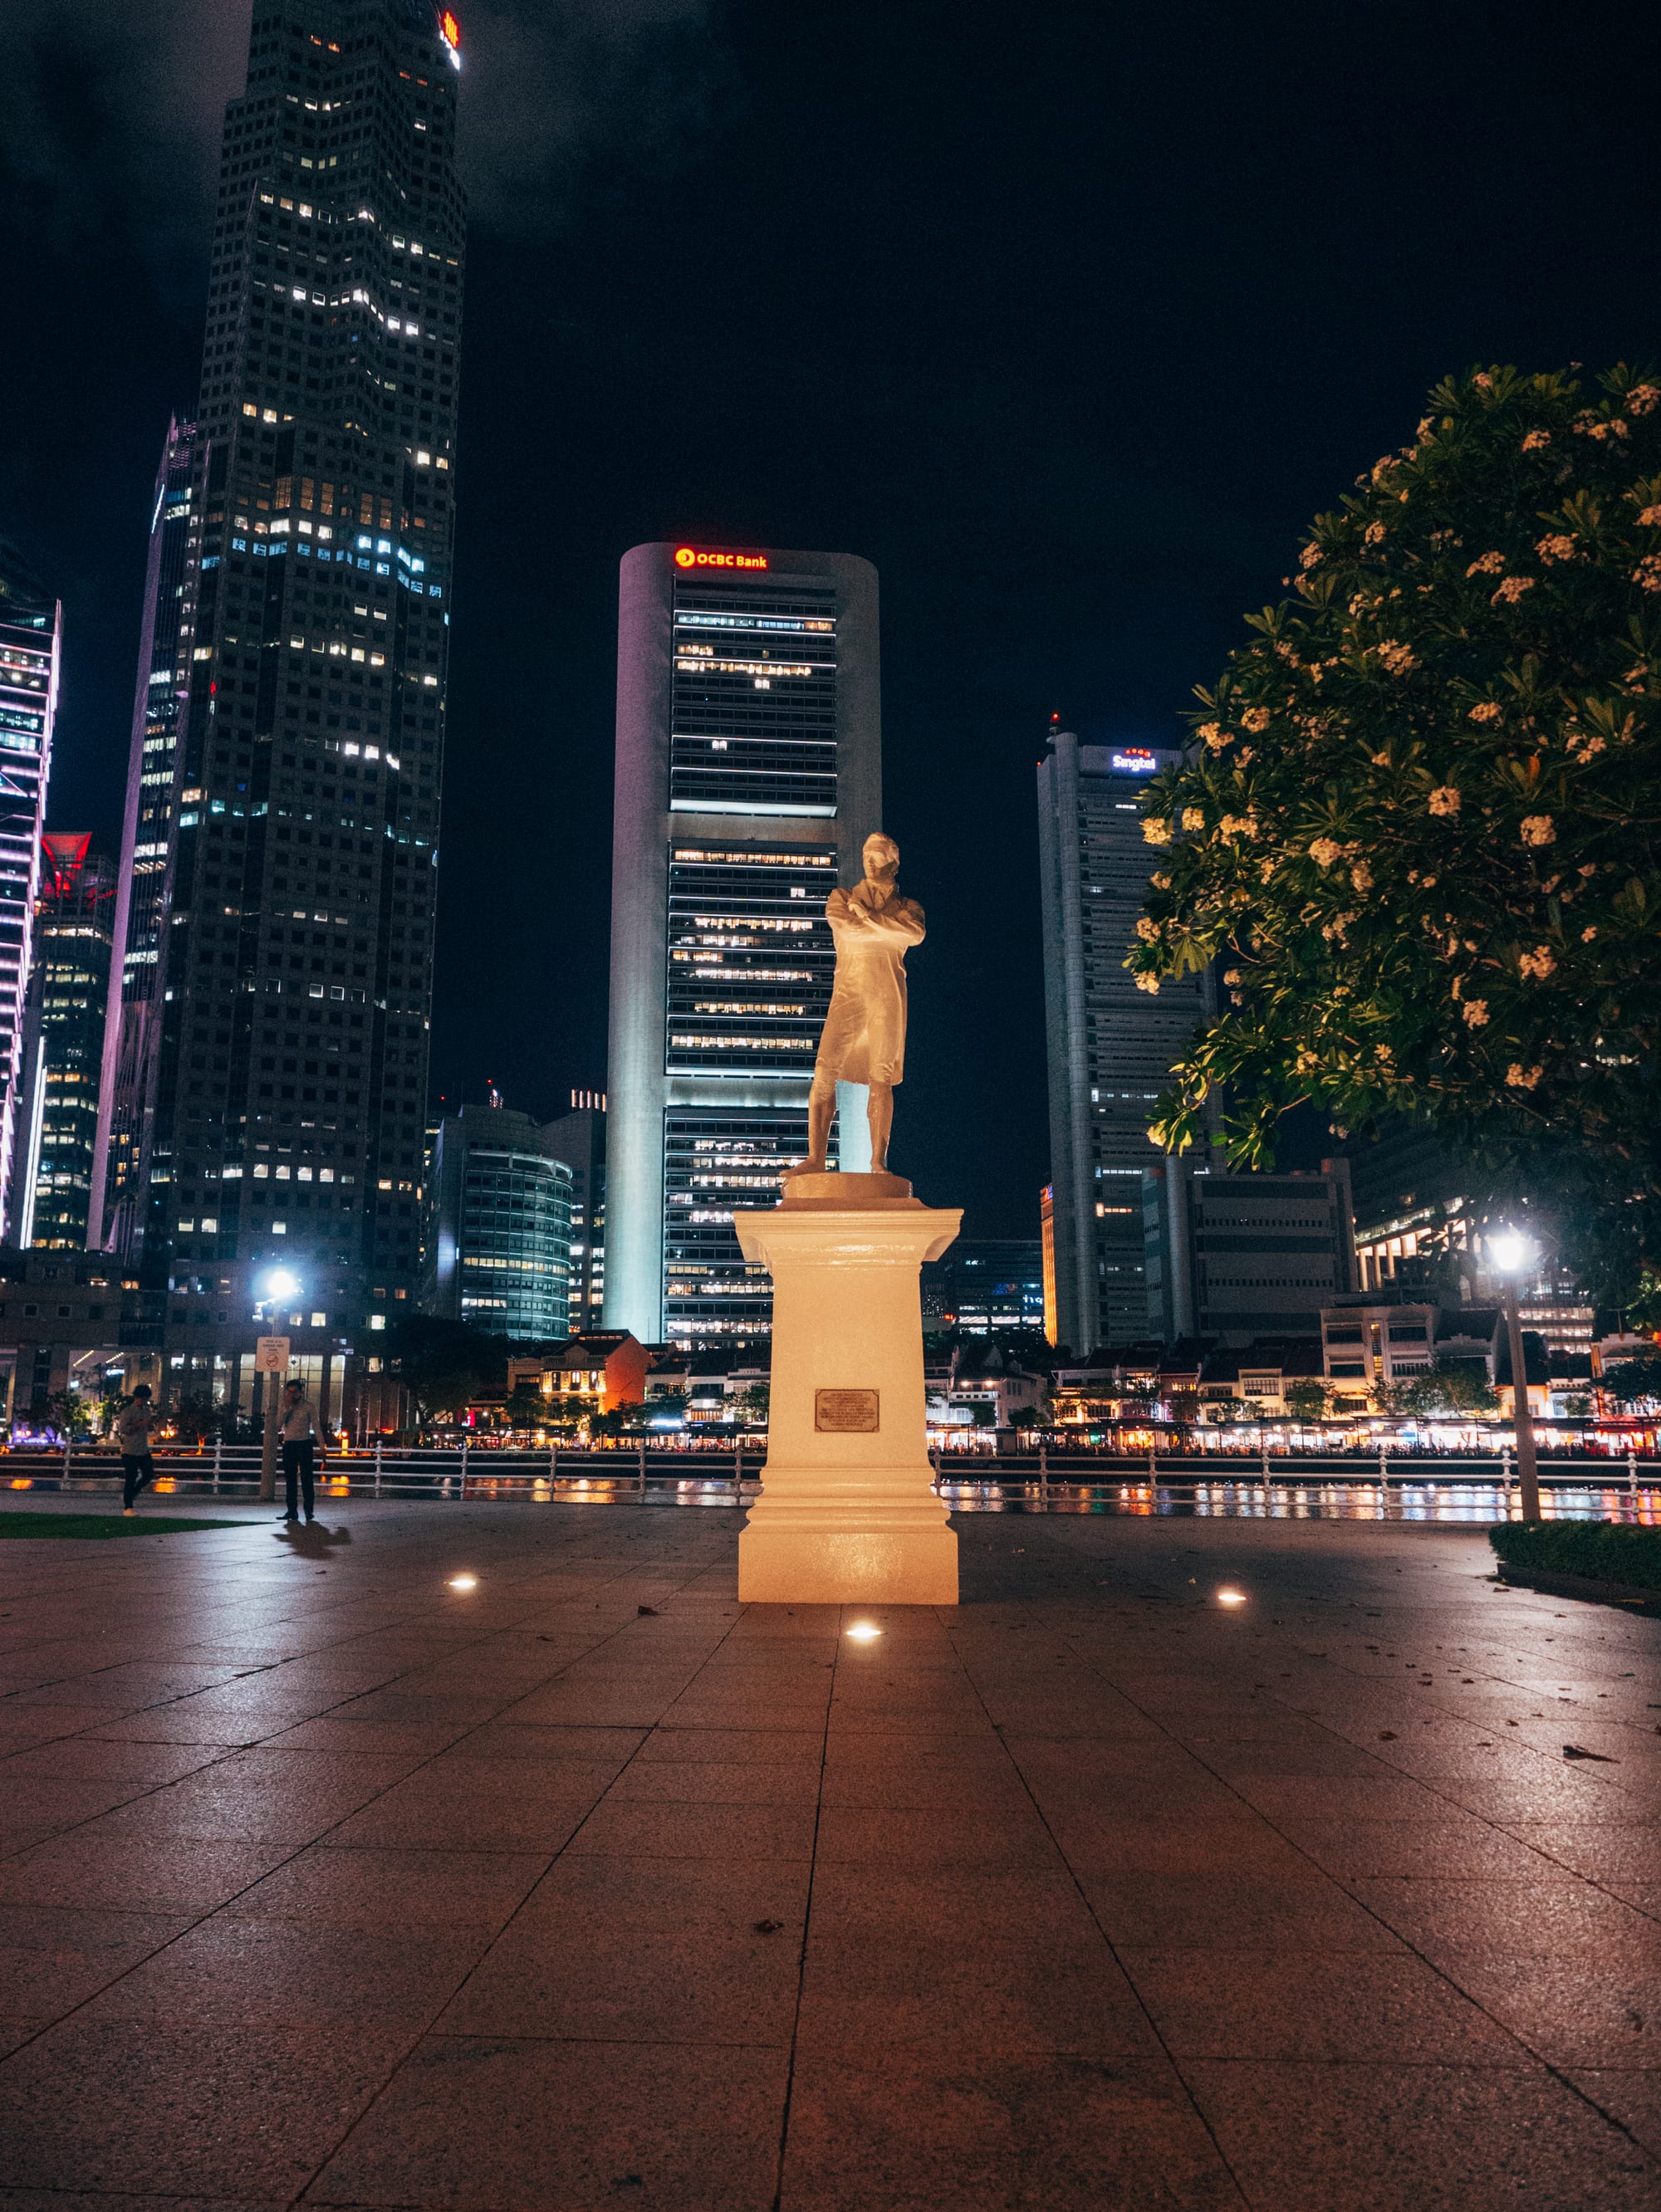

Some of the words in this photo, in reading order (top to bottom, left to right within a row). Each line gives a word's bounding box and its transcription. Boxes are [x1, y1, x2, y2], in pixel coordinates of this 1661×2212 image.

[697, 553, 734, 566] OCBC
[736, 555, 767, 568] Bank
[1113, 755, 1155, 771] Singtel
